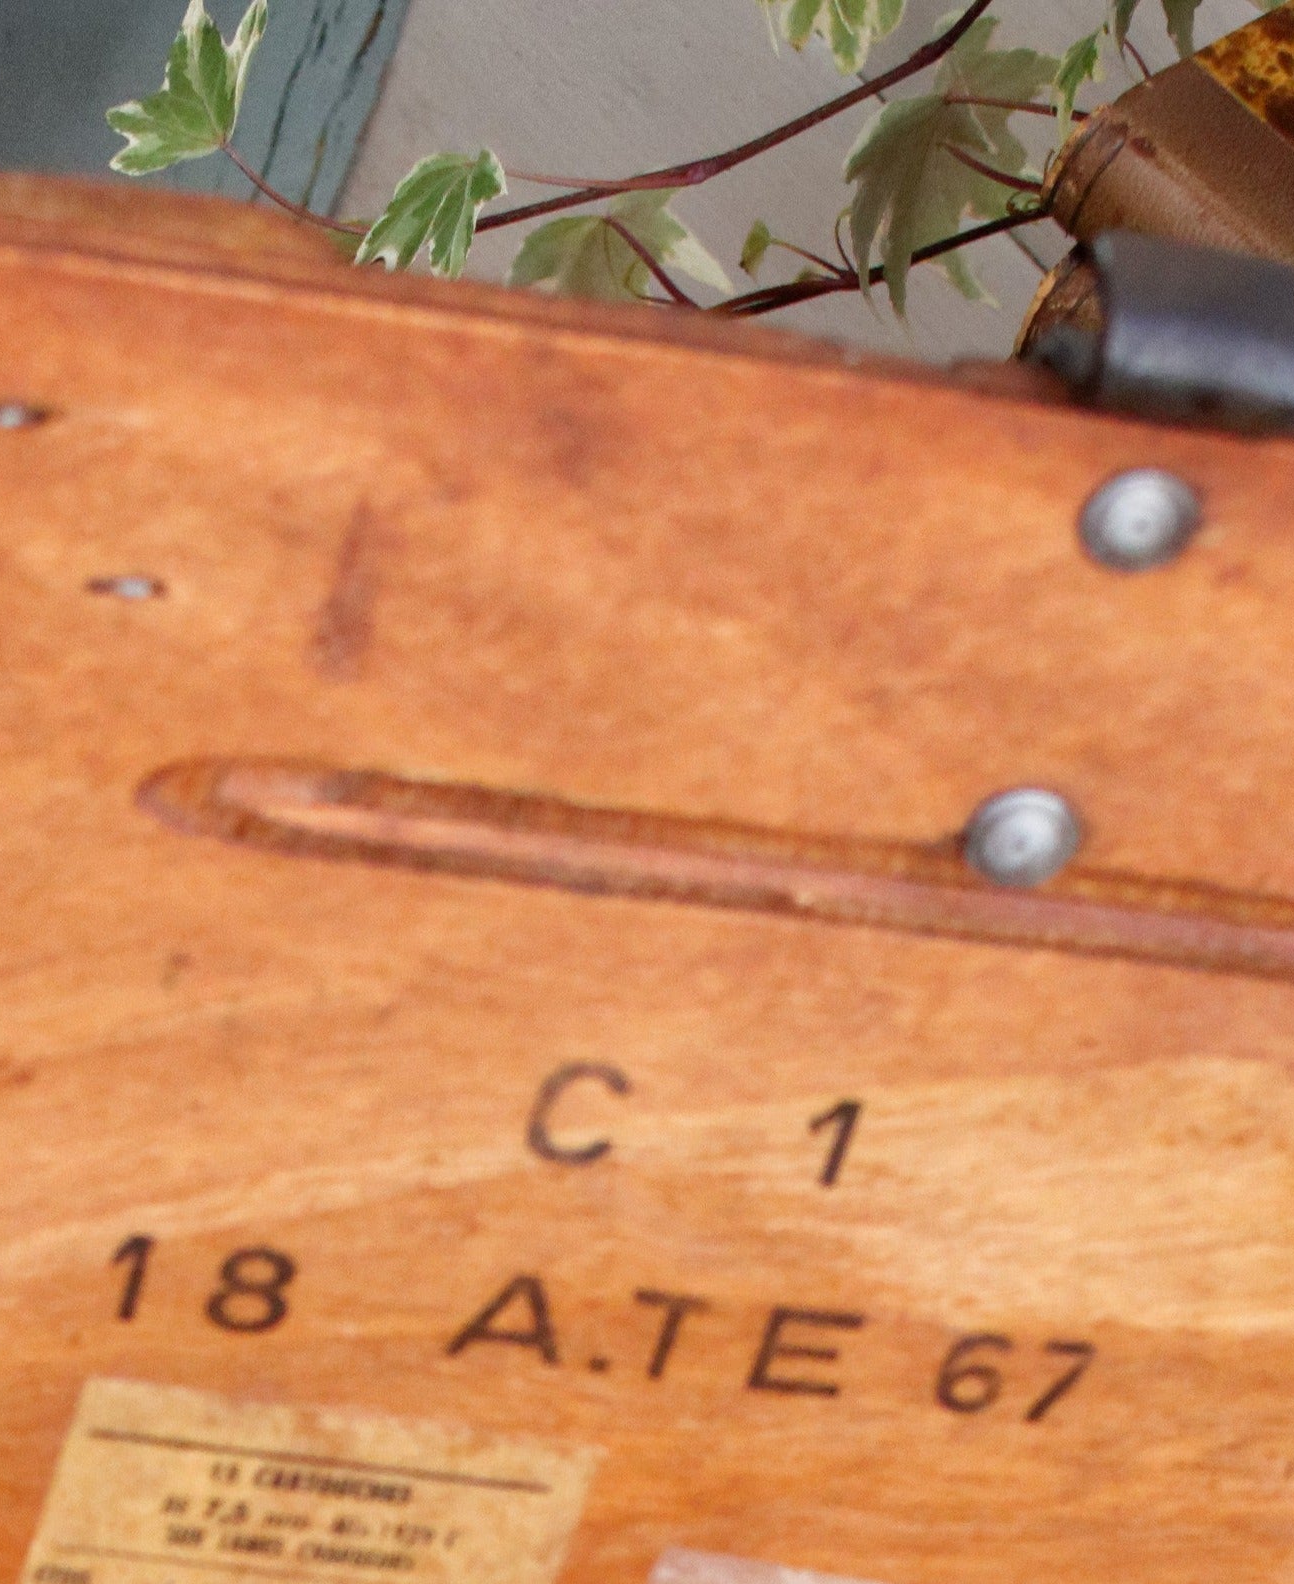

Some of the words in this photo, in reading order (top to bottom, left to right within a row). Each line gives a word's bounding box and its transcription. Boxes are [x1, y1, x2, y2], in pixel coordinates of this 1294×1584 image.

[524, 1060, 630, 1166] C
[807, 1098, 866, 1190] 1
[932, 1332, 1098, 1425] 67
